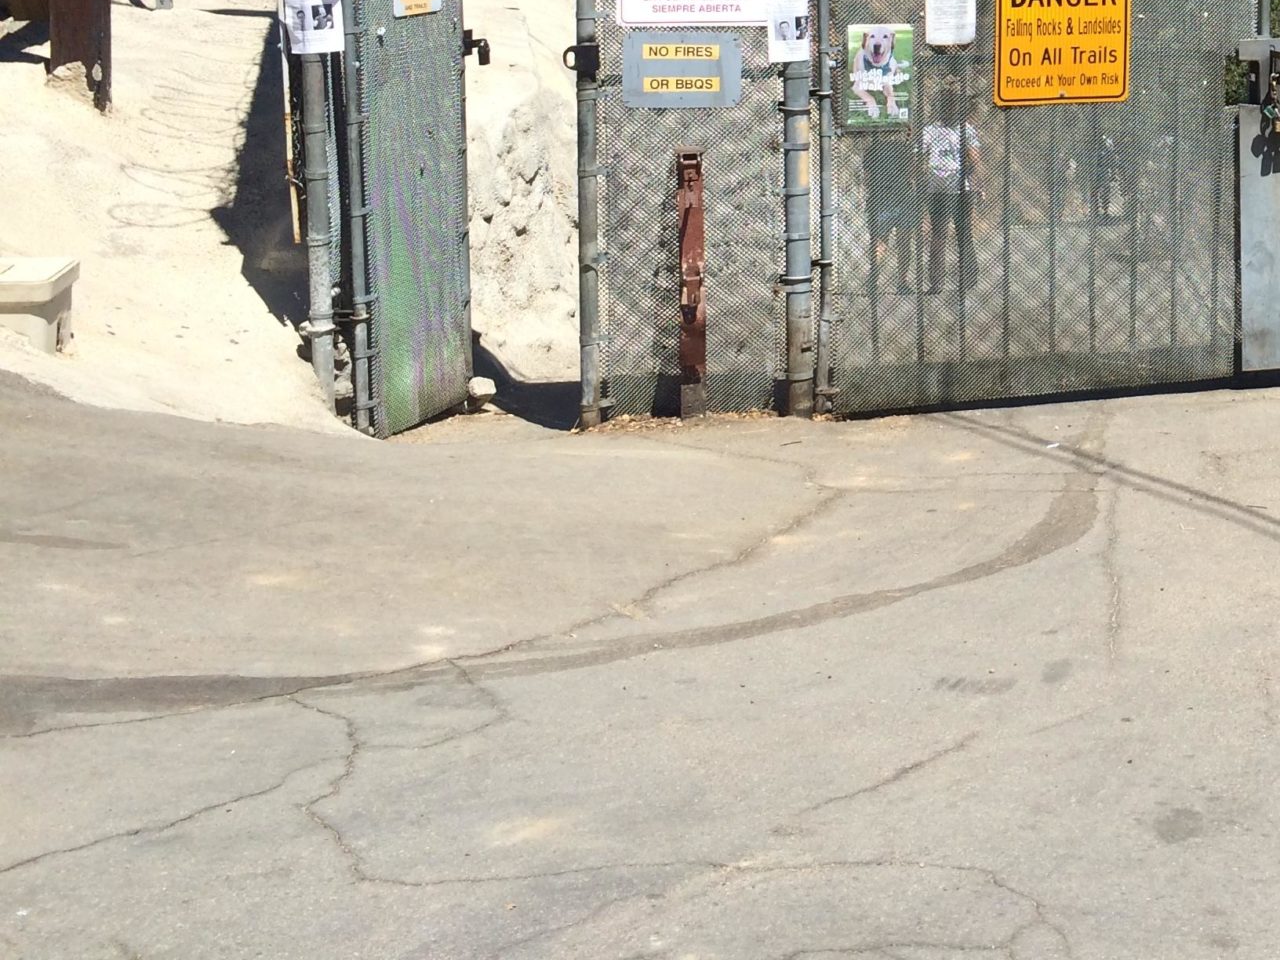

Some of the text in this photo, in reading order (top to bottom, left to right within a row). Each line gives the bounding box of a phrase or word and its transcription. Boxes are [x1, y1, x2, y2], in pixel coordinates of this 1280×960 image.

[652, 4, 742, 13] SIEMPRE ABIERTA
[1006, 16, 1121, 43] Falling Rocks & Landslides
[649, 47, 713, 57] NO FIRES
[1009, 46, 1117, 66] On All Trails
[650, 79, 713, 90] OR BBQS
[1006, 72, 1119, 88] Proceed At Your Own Risk
